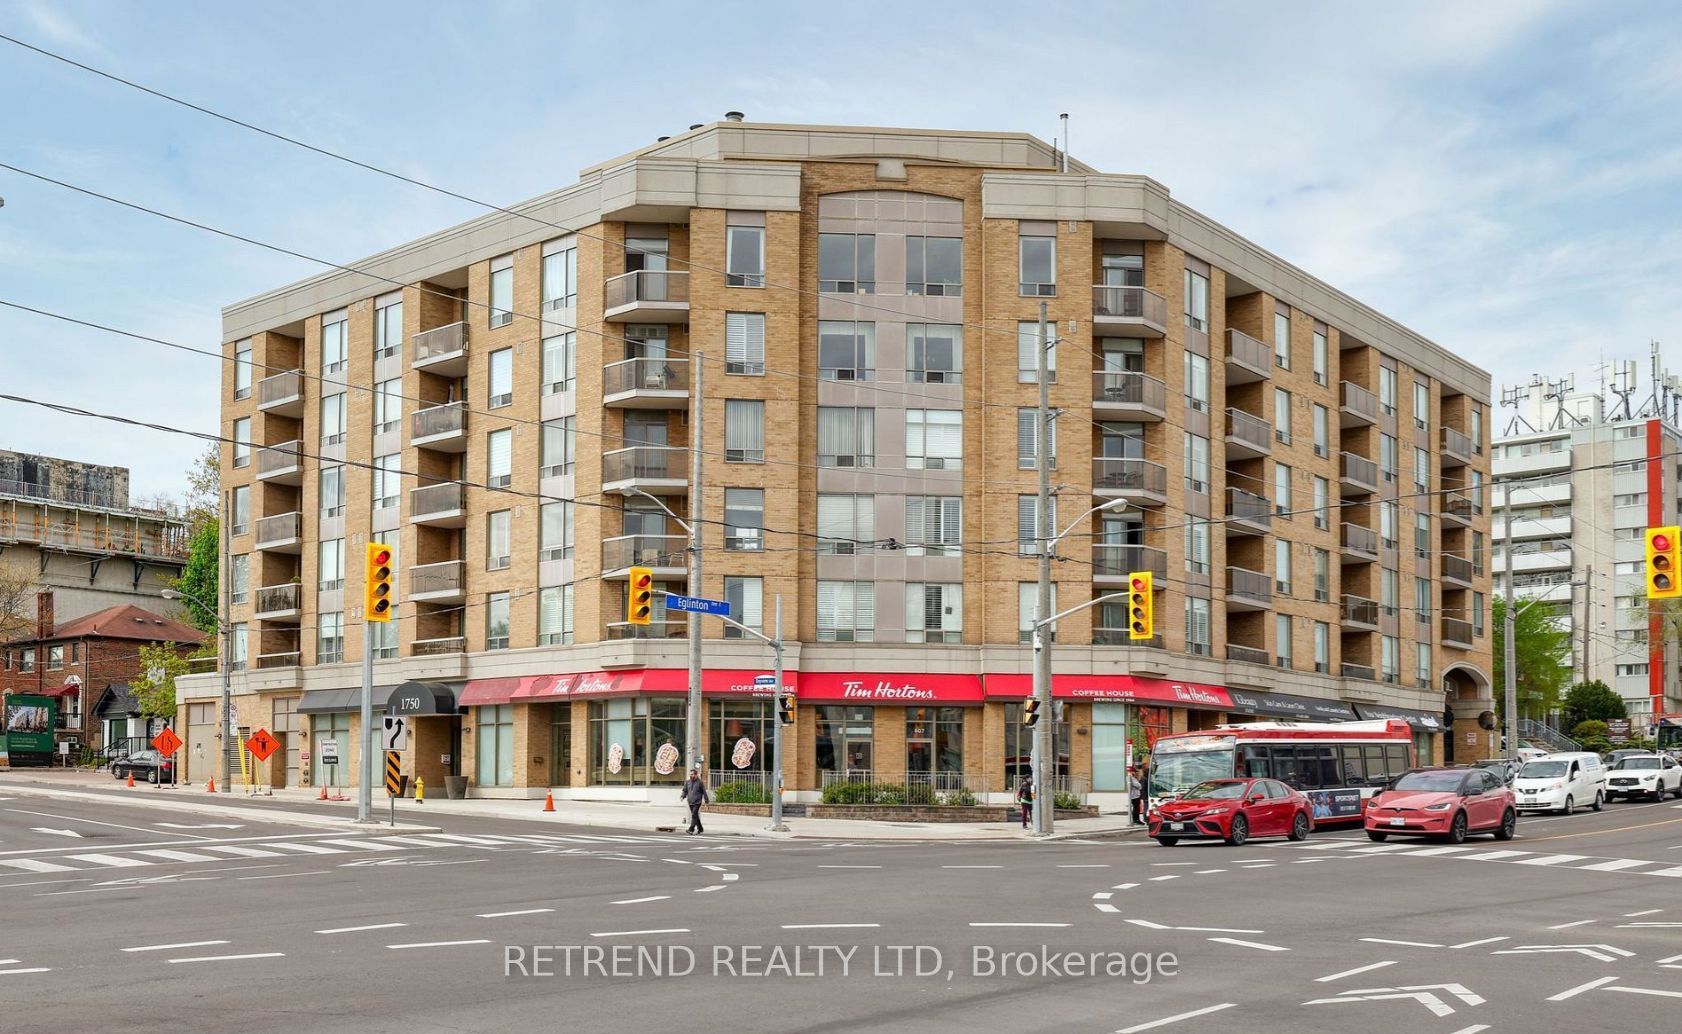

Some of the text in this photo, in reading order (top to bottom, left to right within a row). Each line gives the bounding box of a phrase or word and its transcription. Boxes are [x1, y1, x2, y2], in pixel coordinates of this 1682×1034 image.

[677, 597, 709, 610] Eglinton
[552, 678, 570, 694] Tim
[842, 681, 934, 698] Tim Hortons
[1172, 685, 1191, 700] Tim
[1188, 686, 1220, 704] Hortons
[401, 697, 420, 710] 1750
